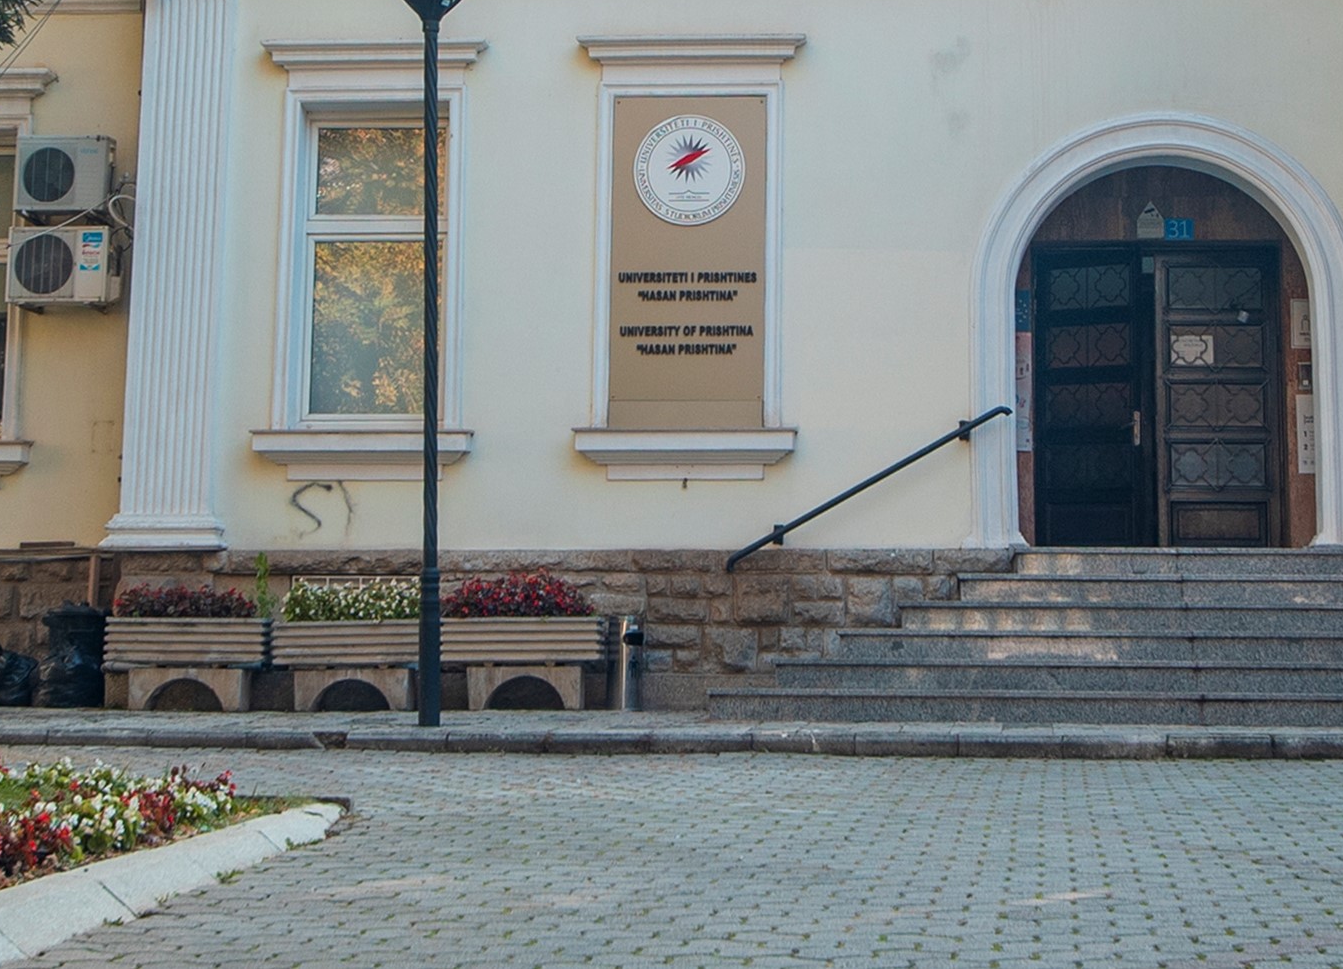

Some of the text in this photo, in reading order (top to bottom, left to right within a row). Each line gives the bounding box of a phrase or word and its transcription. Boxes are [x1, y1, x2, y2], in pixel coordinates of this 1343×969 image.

[1168, 220, 1190, 238] 31
[618, 272, 688, 283] UNIVERSITETI
[690, 272, 695, 283] I
[619, 325, 754, 337] UNIVERSITY OF PRISHTINA
